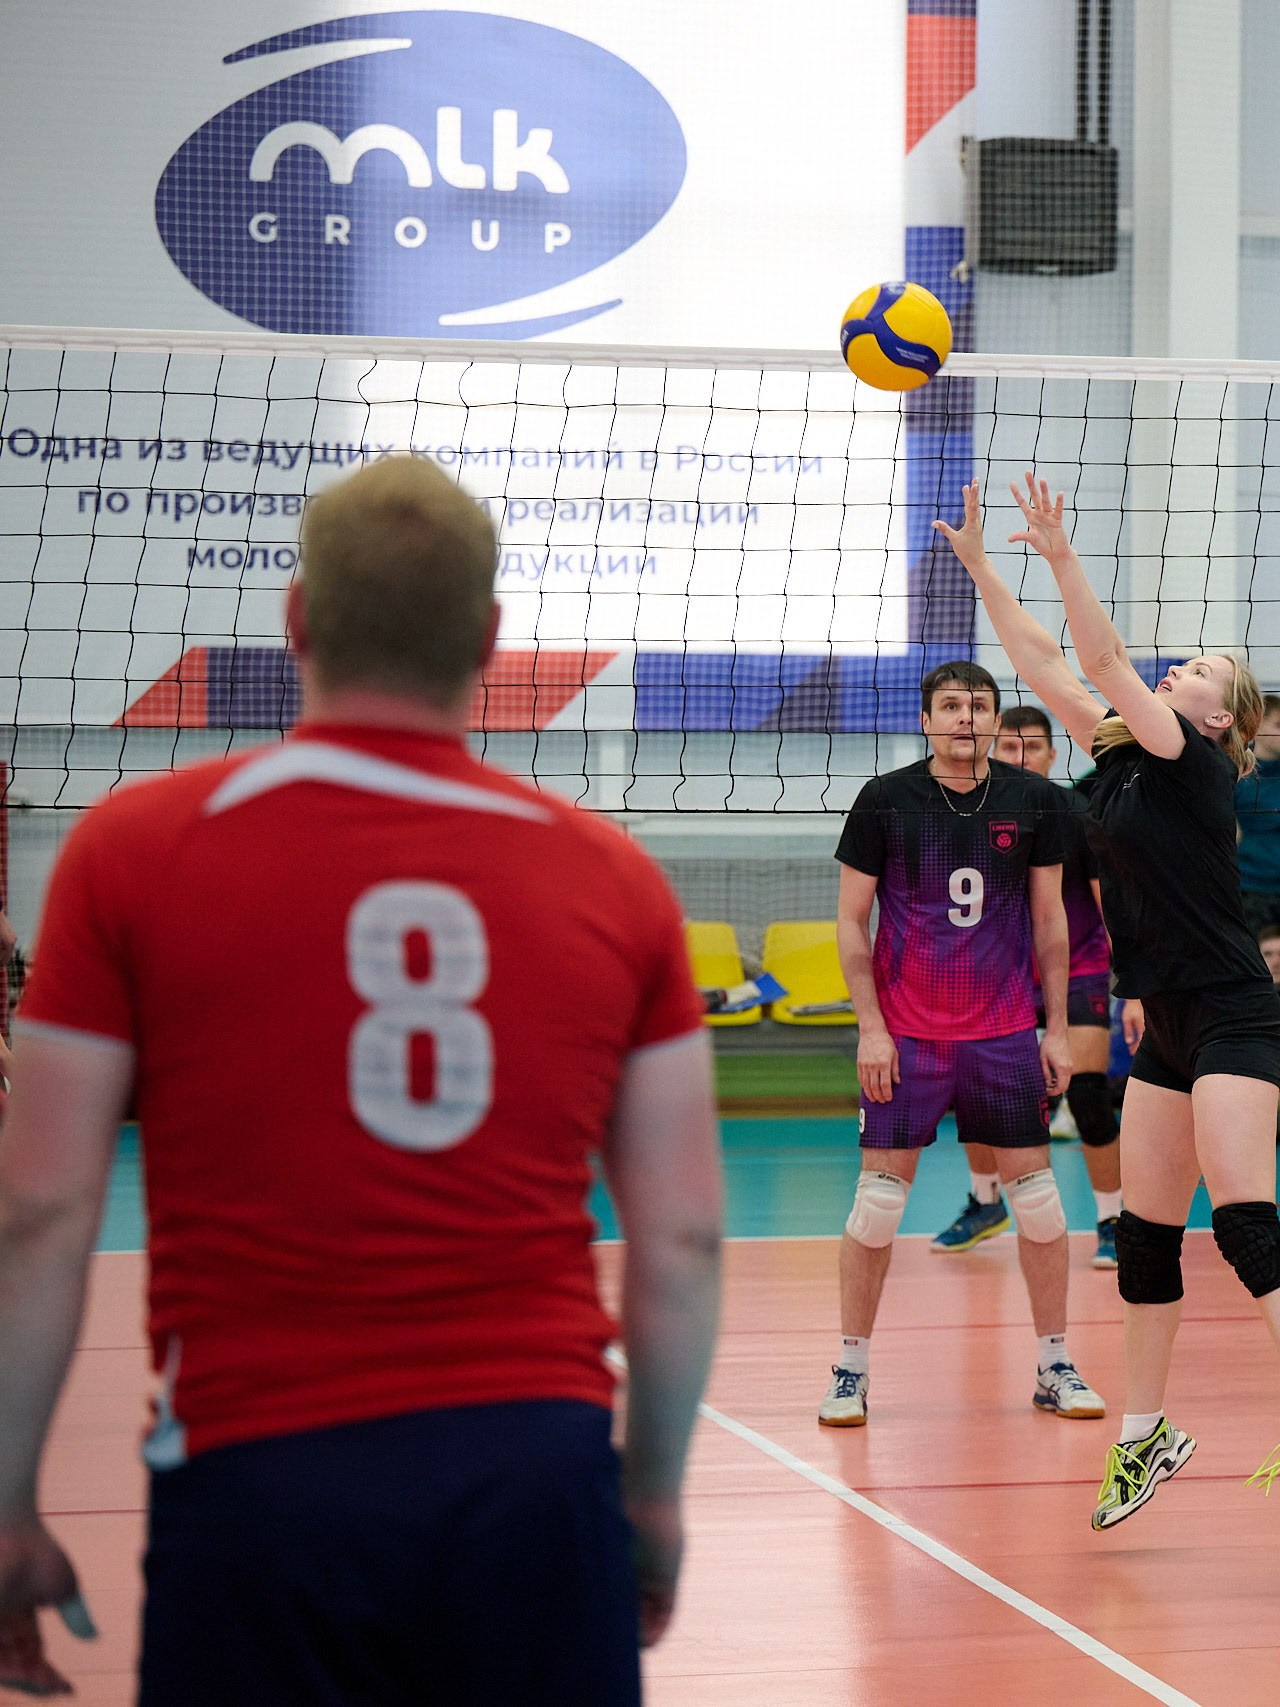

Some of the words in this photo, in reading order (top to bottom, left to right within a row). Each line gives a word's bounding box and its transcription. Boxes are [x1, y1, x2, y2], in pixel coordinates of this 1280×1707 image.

[248, 106, 570, 194] mlk
[248, 211, 572, 254] GROUP
[7, 428, 123, 463] Одна
[138, 440, 188, 462] из
[202, 437, 394, 471] ведущих
[412, 441, 624, 470] компаний
[640, 451, 659, 472] в
[676, 446, 823, 475] России
[78, 491, 130, 515] по
[147, 491, 302, 522] произв
[508, 499, 760, 528] реализации
[188, 546, 297, 571] моло
[500, 552, 657, 582] дукции
[948, 867, 984, 928] 9
[345, 879, 495, 1152] 8
